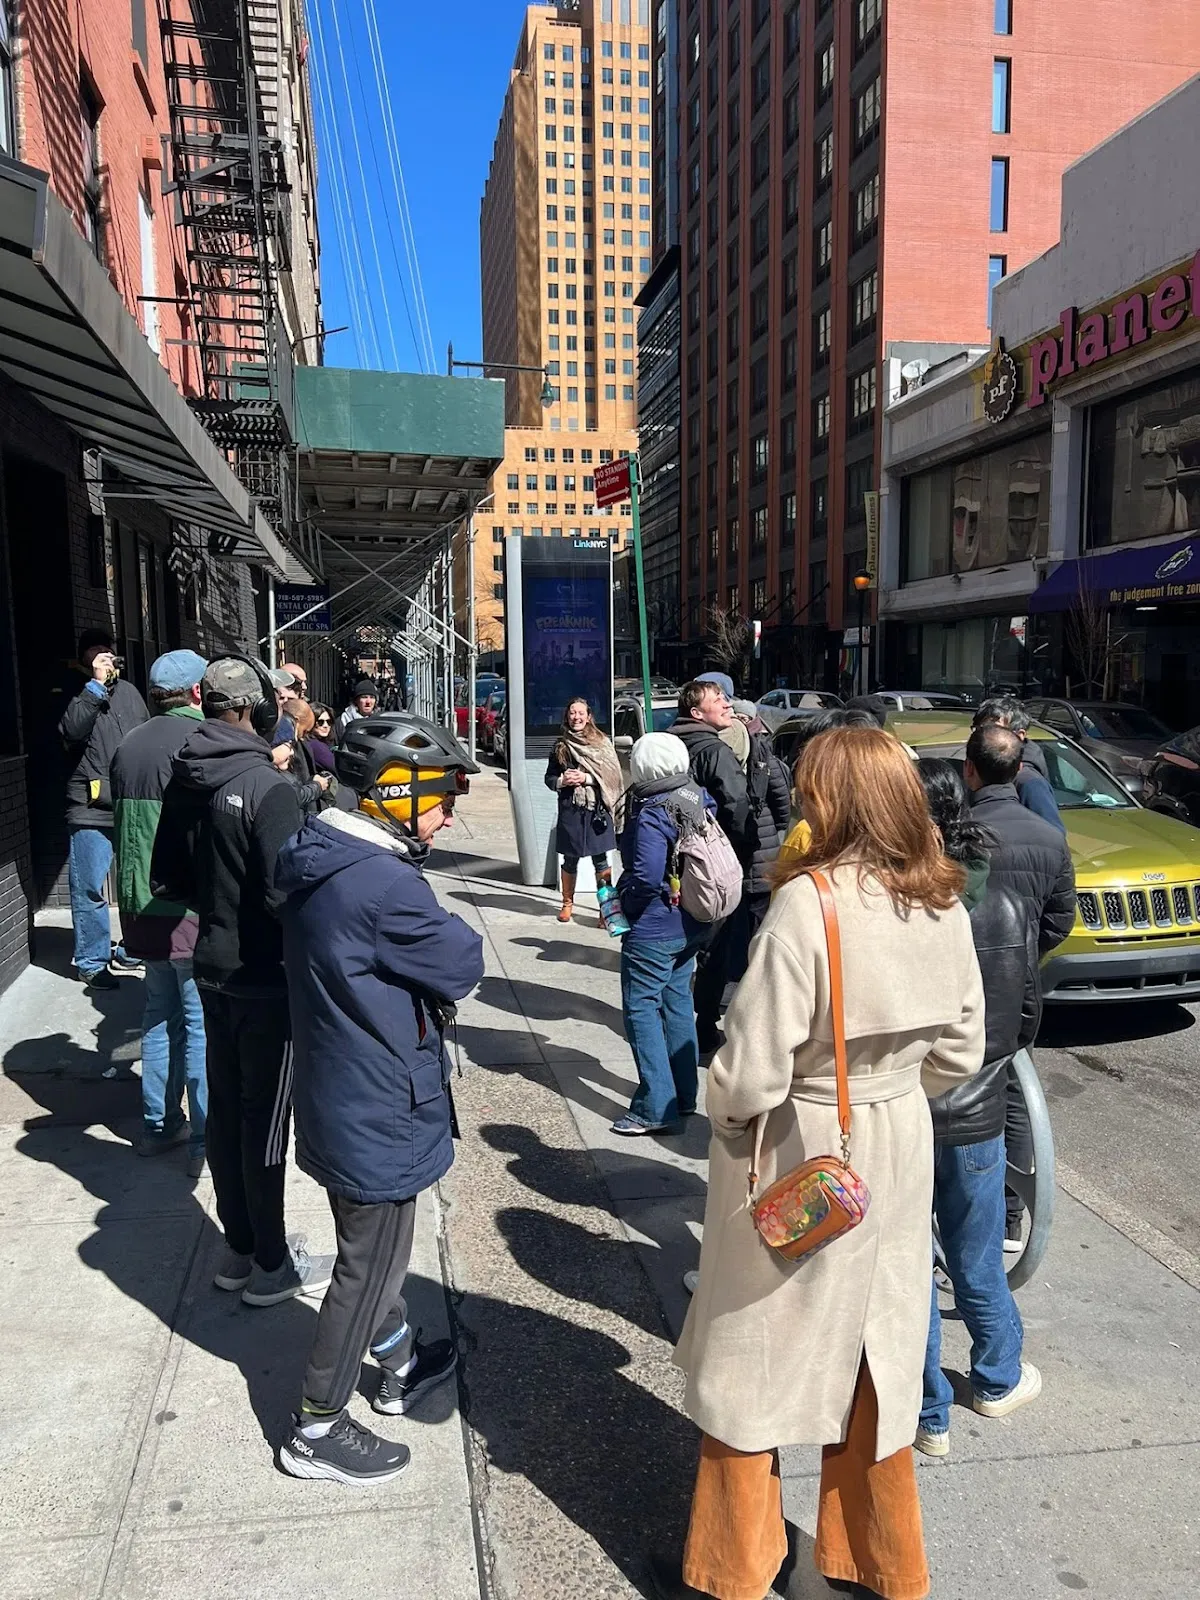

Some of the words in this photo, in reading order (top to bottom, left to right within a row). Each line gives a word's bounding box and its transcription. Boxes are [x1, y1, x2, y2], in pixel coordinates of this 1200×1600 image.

[989, 374, 1009, 404] pf
[596, 470, 605, 480] NO
[605, 460, 629, 477] STANDIN
[597, 476, 620, 489] Anytime
[868, 496, 876, 533] fitness
[574, 540, 608, 549] LinkNYC
[868, 536, 876, 573] planet
[1110, 589, 1122, 602] the
[1123, 585, 1165, 603] judgement
[1166, 583, 1184, 597] free
[1186, 583, 1200, 595] zon
[302, 602, 327, 611] OFE
[283, 613, 318, 622] MECAL
[315, 622, 329, 631] SPA
[377, 783, 412, 798] vex
[1142, 872, 1165, 881] Jeep
[291, 1436, 314, 1458] HOKA
